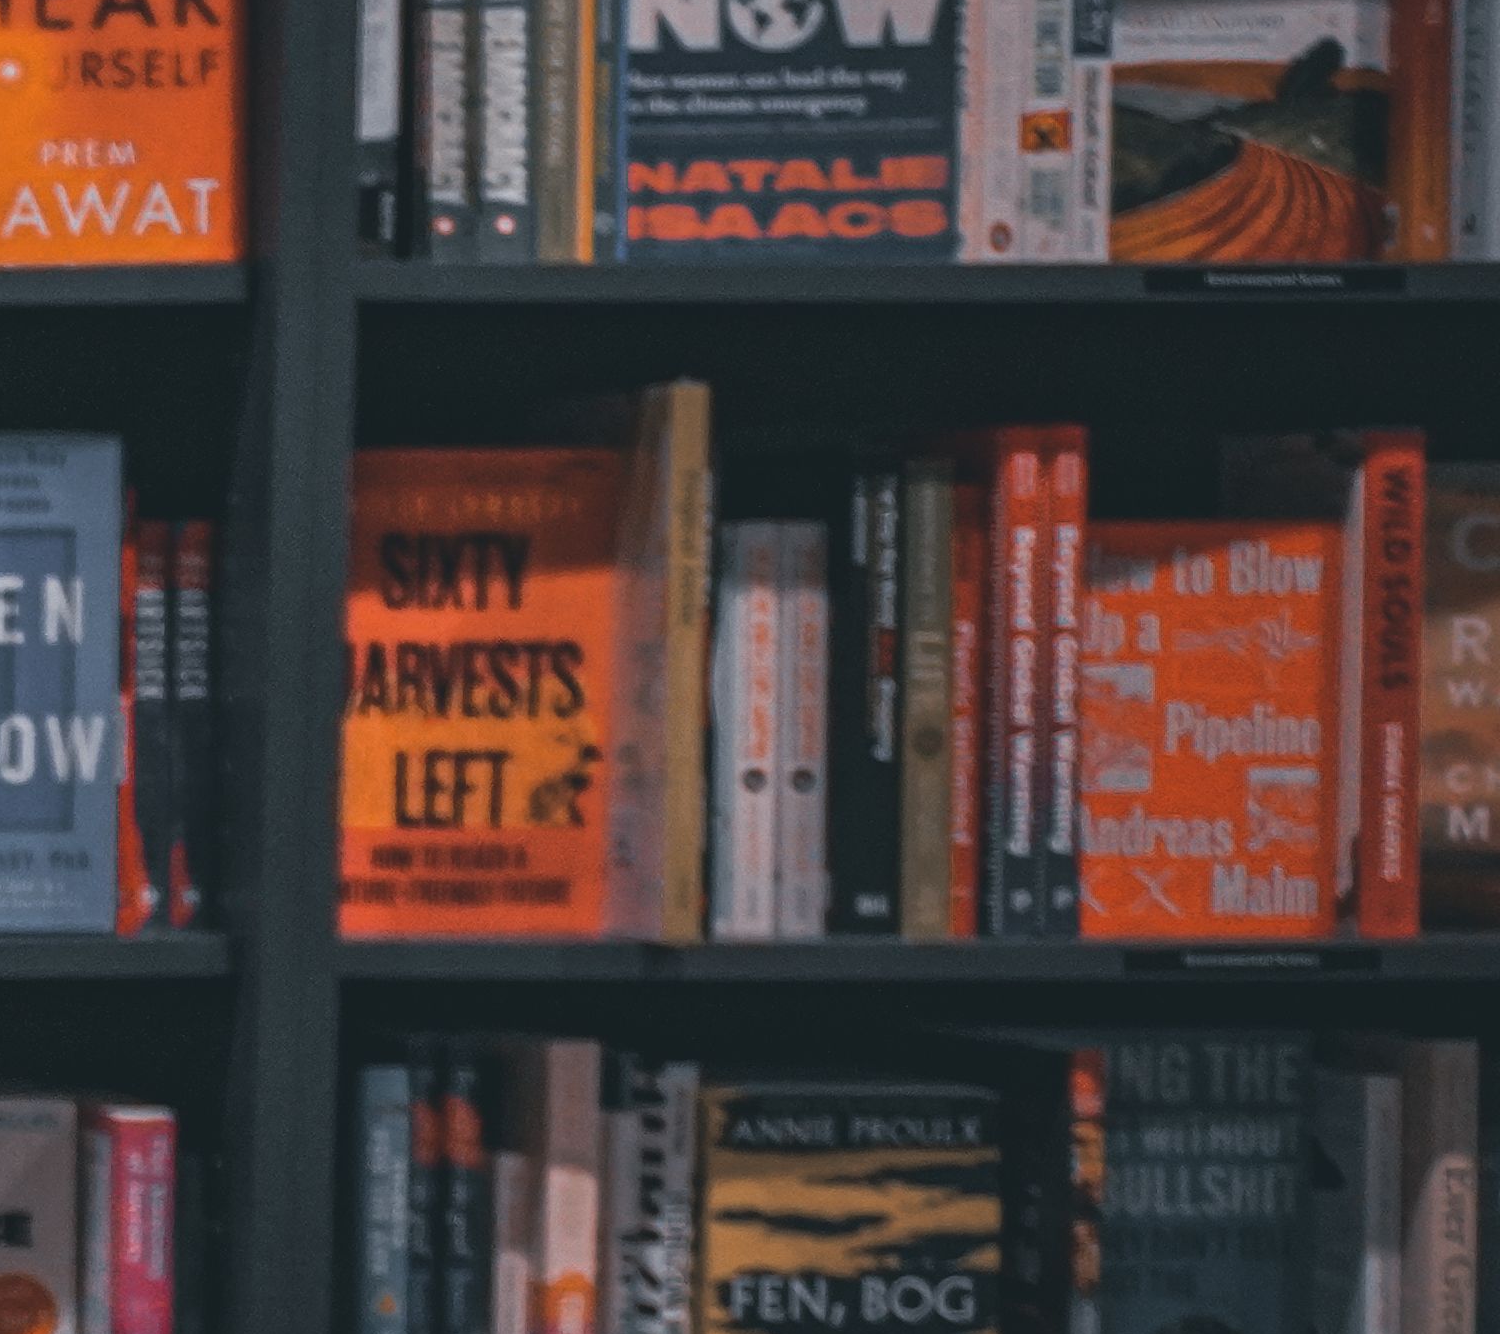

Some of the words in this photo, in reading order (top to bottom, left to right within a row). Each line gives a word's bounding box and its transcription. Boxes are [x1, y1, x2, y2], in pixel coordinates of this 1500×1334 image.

[38, 139, 136, 168] PREM
[628, 158, 948, 191] NATALIE
[628, 201, 948, 239] ISAACS
[379, 531, 532, 612] SIXTY
[1170, 553, 1215, 597] to
[1227, 549, 1322, 598] Blow
[1164, 702, 1322, 764] Pipeline
[393, 752, 506, 830] LEFT
[1210, 867, 1321, 919] Malm
[729, 1114, 839, 1146] ANNIE
[849, 1114, 981, 1146] PROULX
[728, 1275, 833, 1327] FEN,
[861, 1275, 976, 1323] BOG
